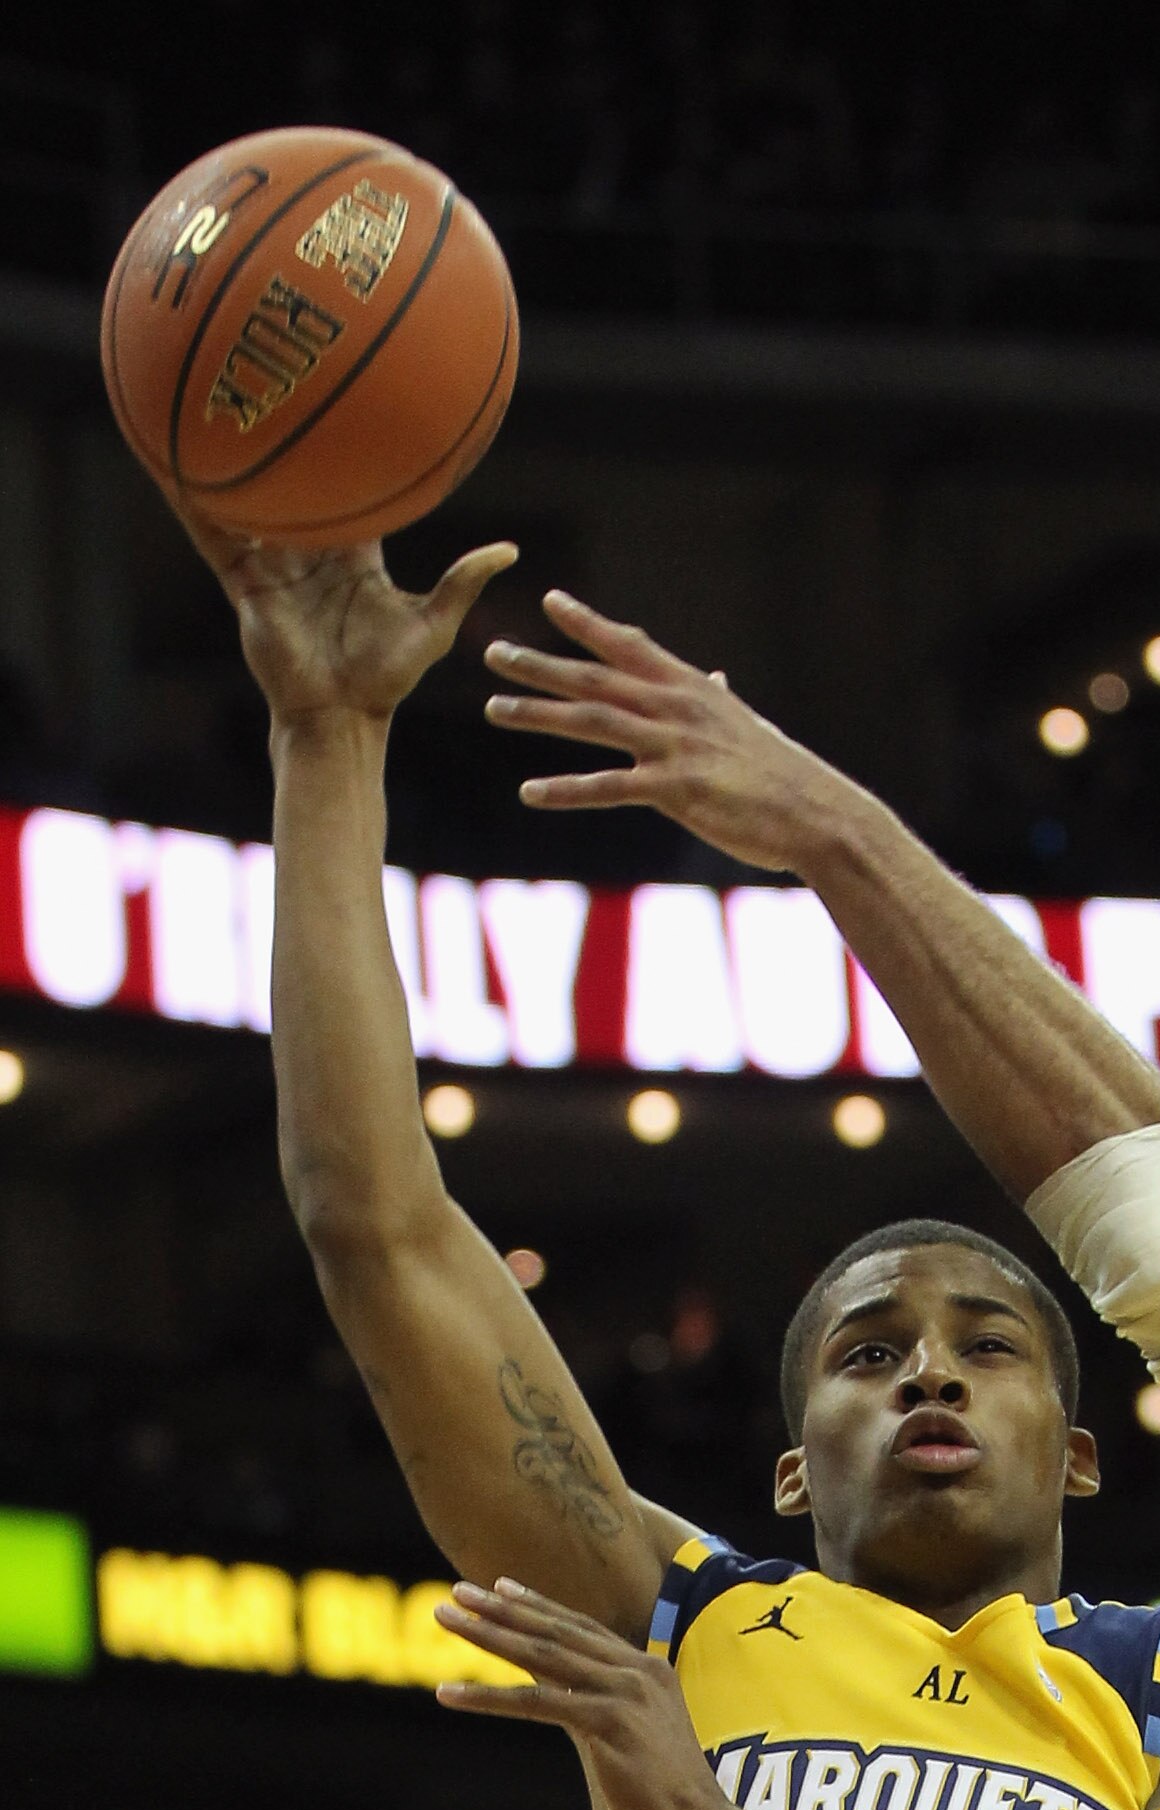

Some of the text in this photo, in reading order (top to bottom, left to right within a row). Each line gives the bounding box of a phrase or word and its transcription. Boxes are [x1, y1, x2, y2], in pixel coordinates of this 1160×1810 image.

[203, 178, 411, 434] THE ROCK
[911, 1664, 970, 1706] AL
